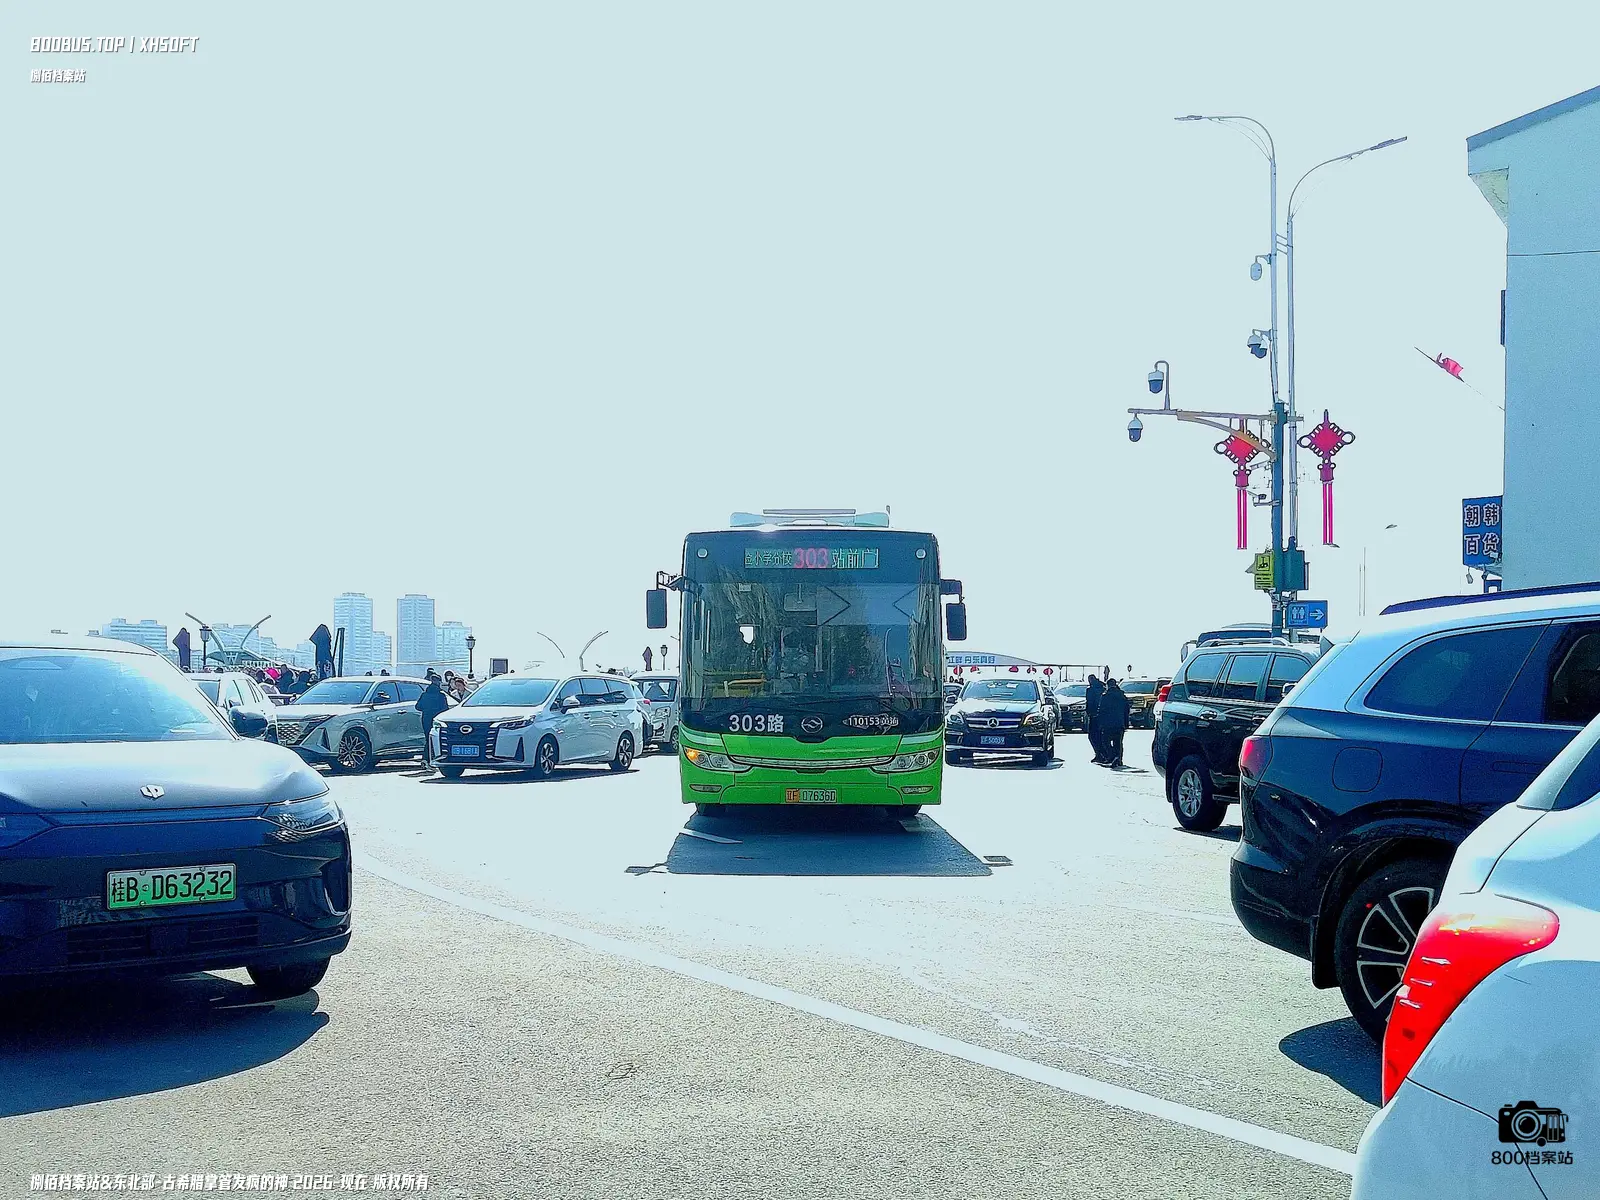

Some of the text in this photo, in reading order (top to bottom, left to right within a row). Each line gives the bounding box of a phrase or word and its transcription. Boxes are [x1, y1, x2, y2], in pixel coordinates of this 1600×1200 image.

[1464, 503, 1499, 527] 朝韩
[1464, 533, 1499, 555] 百货
[794, 548, 829, 569] 303
[729, 714, 784, 733] 303路
